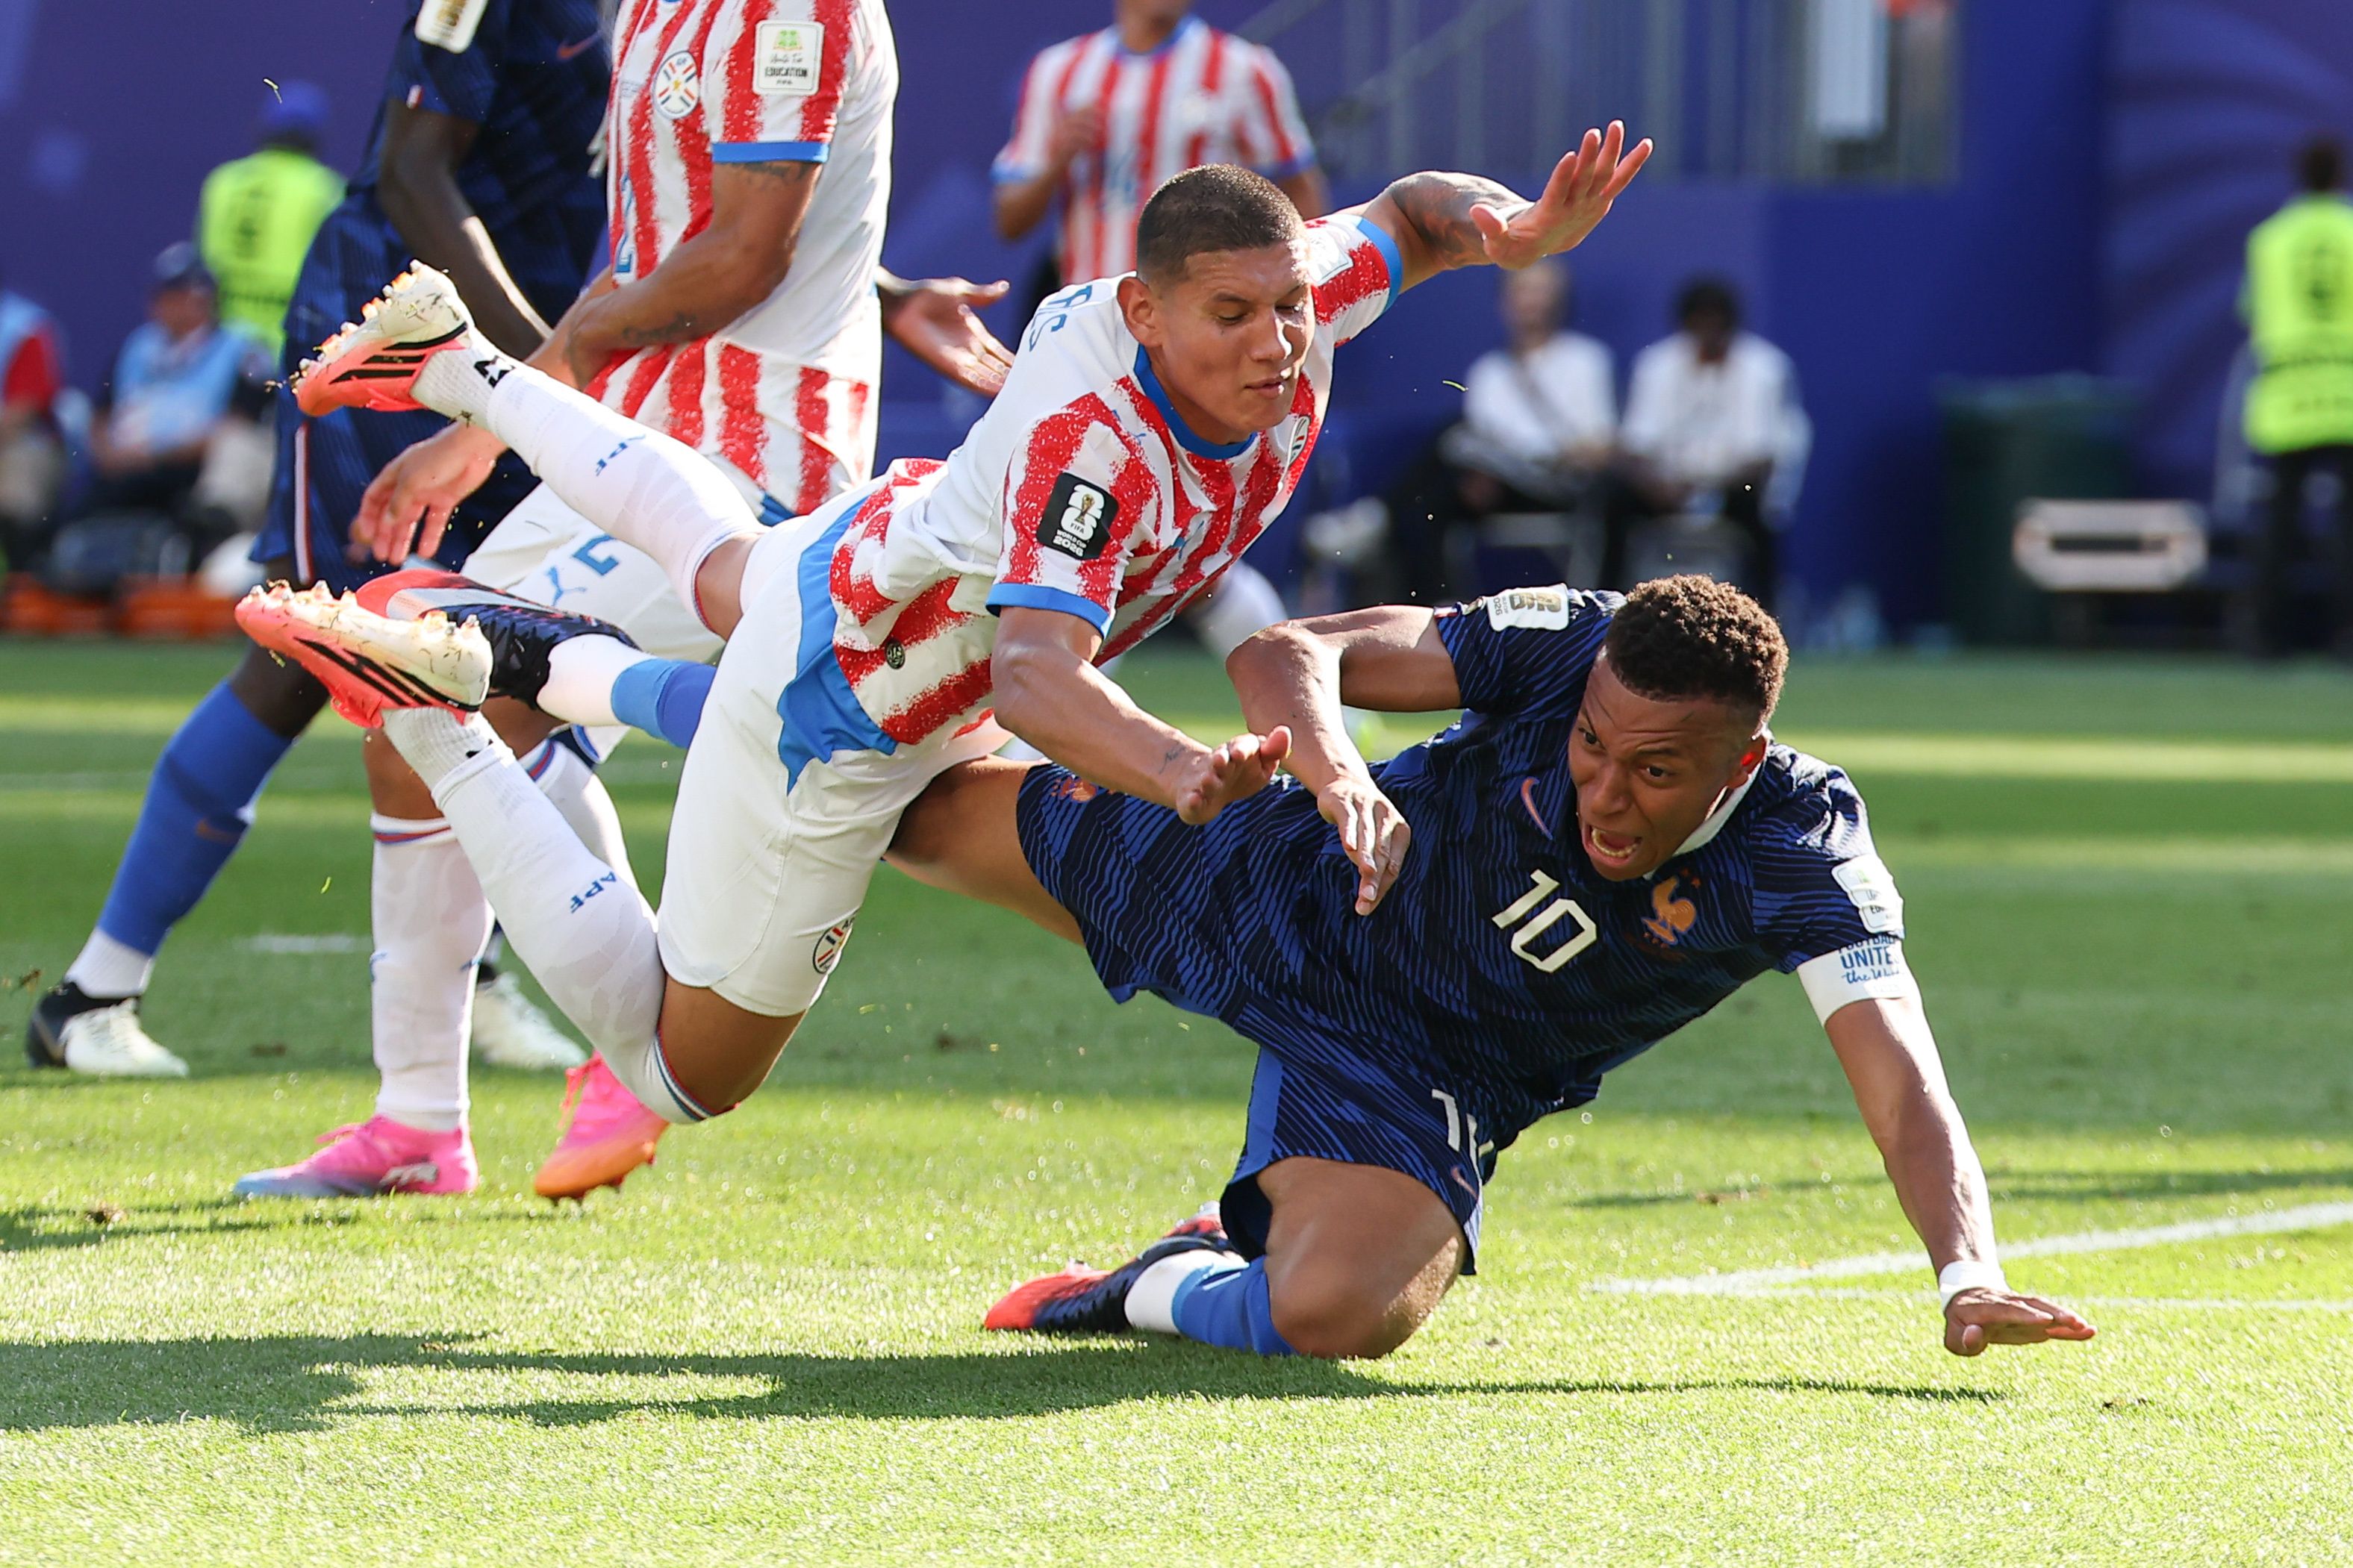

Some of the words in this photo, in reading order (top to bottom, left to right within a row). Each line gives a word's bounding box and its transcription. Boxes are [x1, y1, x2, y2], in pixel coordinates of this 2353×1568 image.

[1056, 529, 1077, 543] WORLD
[1070, 522, 1085, 534] FIFA
[1053, 535, 1084, 557] 2026
[1493, 596, 1503, 616] 026
[570, 872, 616, 913] APF
[1492, 868, 1597, 973] 10
[1839, 944, 1898, 969] UNITE
